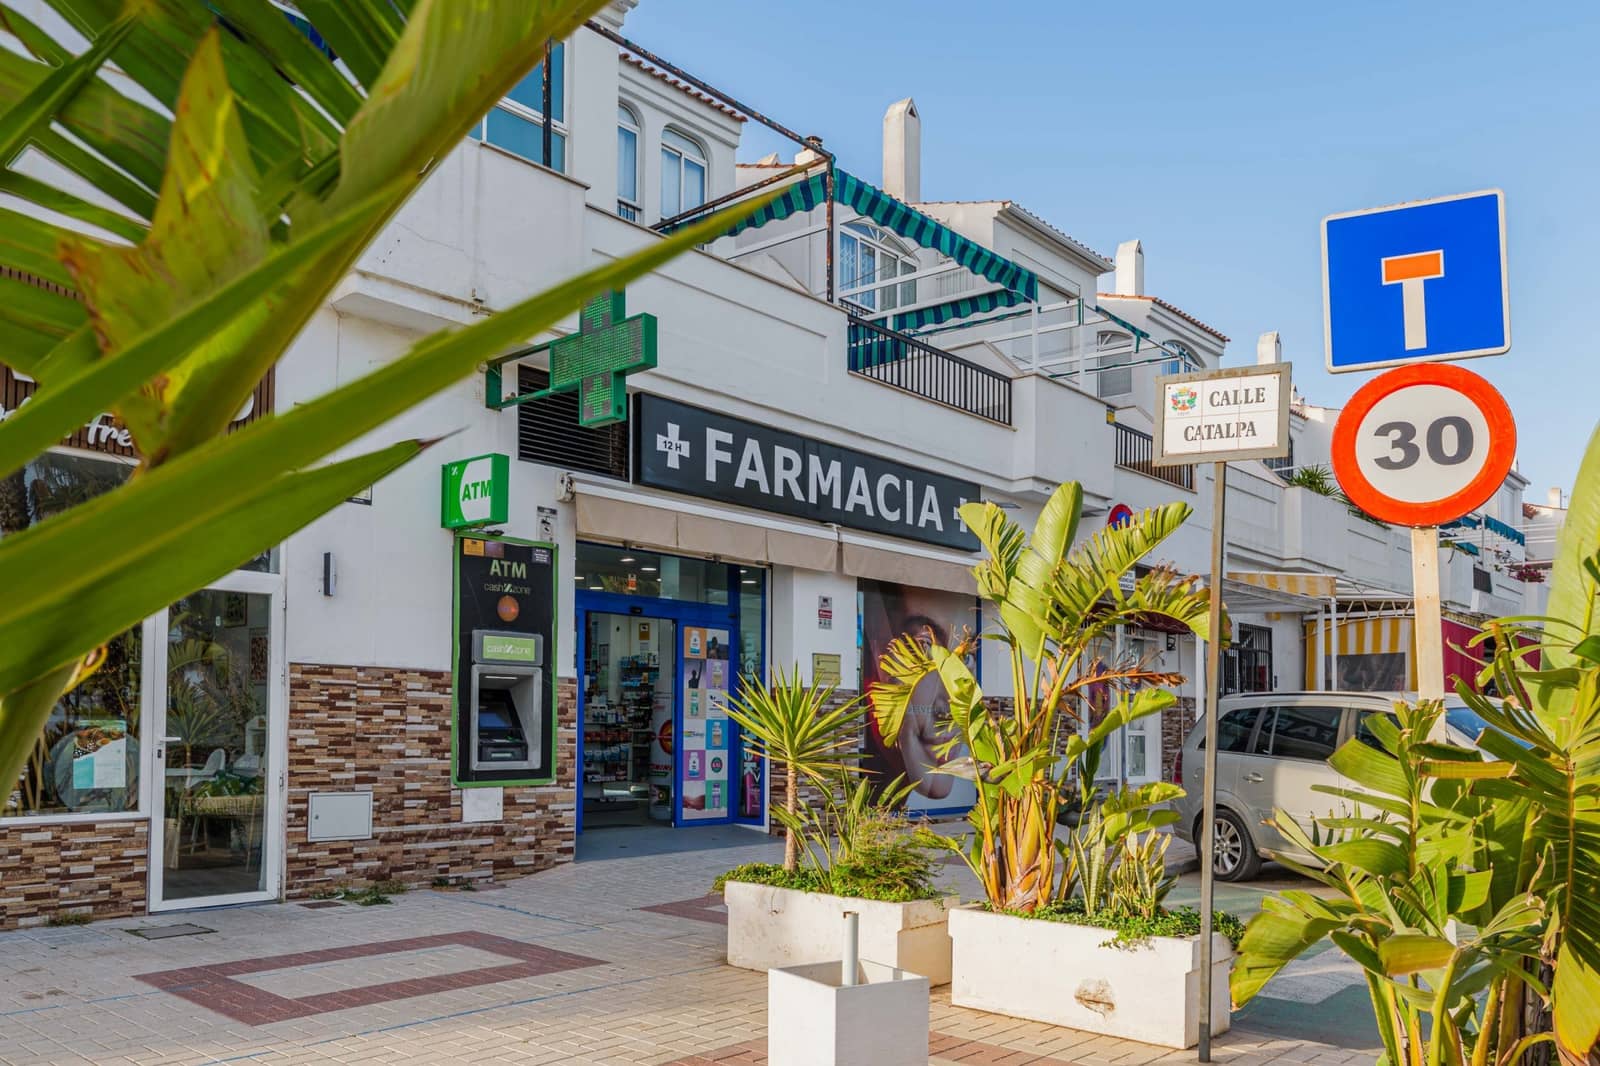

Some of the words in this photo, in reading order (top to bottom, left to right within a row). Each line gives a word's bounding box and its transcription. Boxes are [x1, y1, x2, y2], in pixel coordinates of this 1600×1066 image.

[1209, 387, 1266, 408] CALLE
[85, 412, 133, 447] fre
[1184, 421, 1257, 441] CATALPA
[663, 440, 673, 450] 12
[675, 442, 682, 453] H
[1373, 416, 1474, 470] 30
[705, 427, 943, 531] FARMACIA
[462, 480, 492, 501] ATM
[489, 559, 527, 579] ATM
